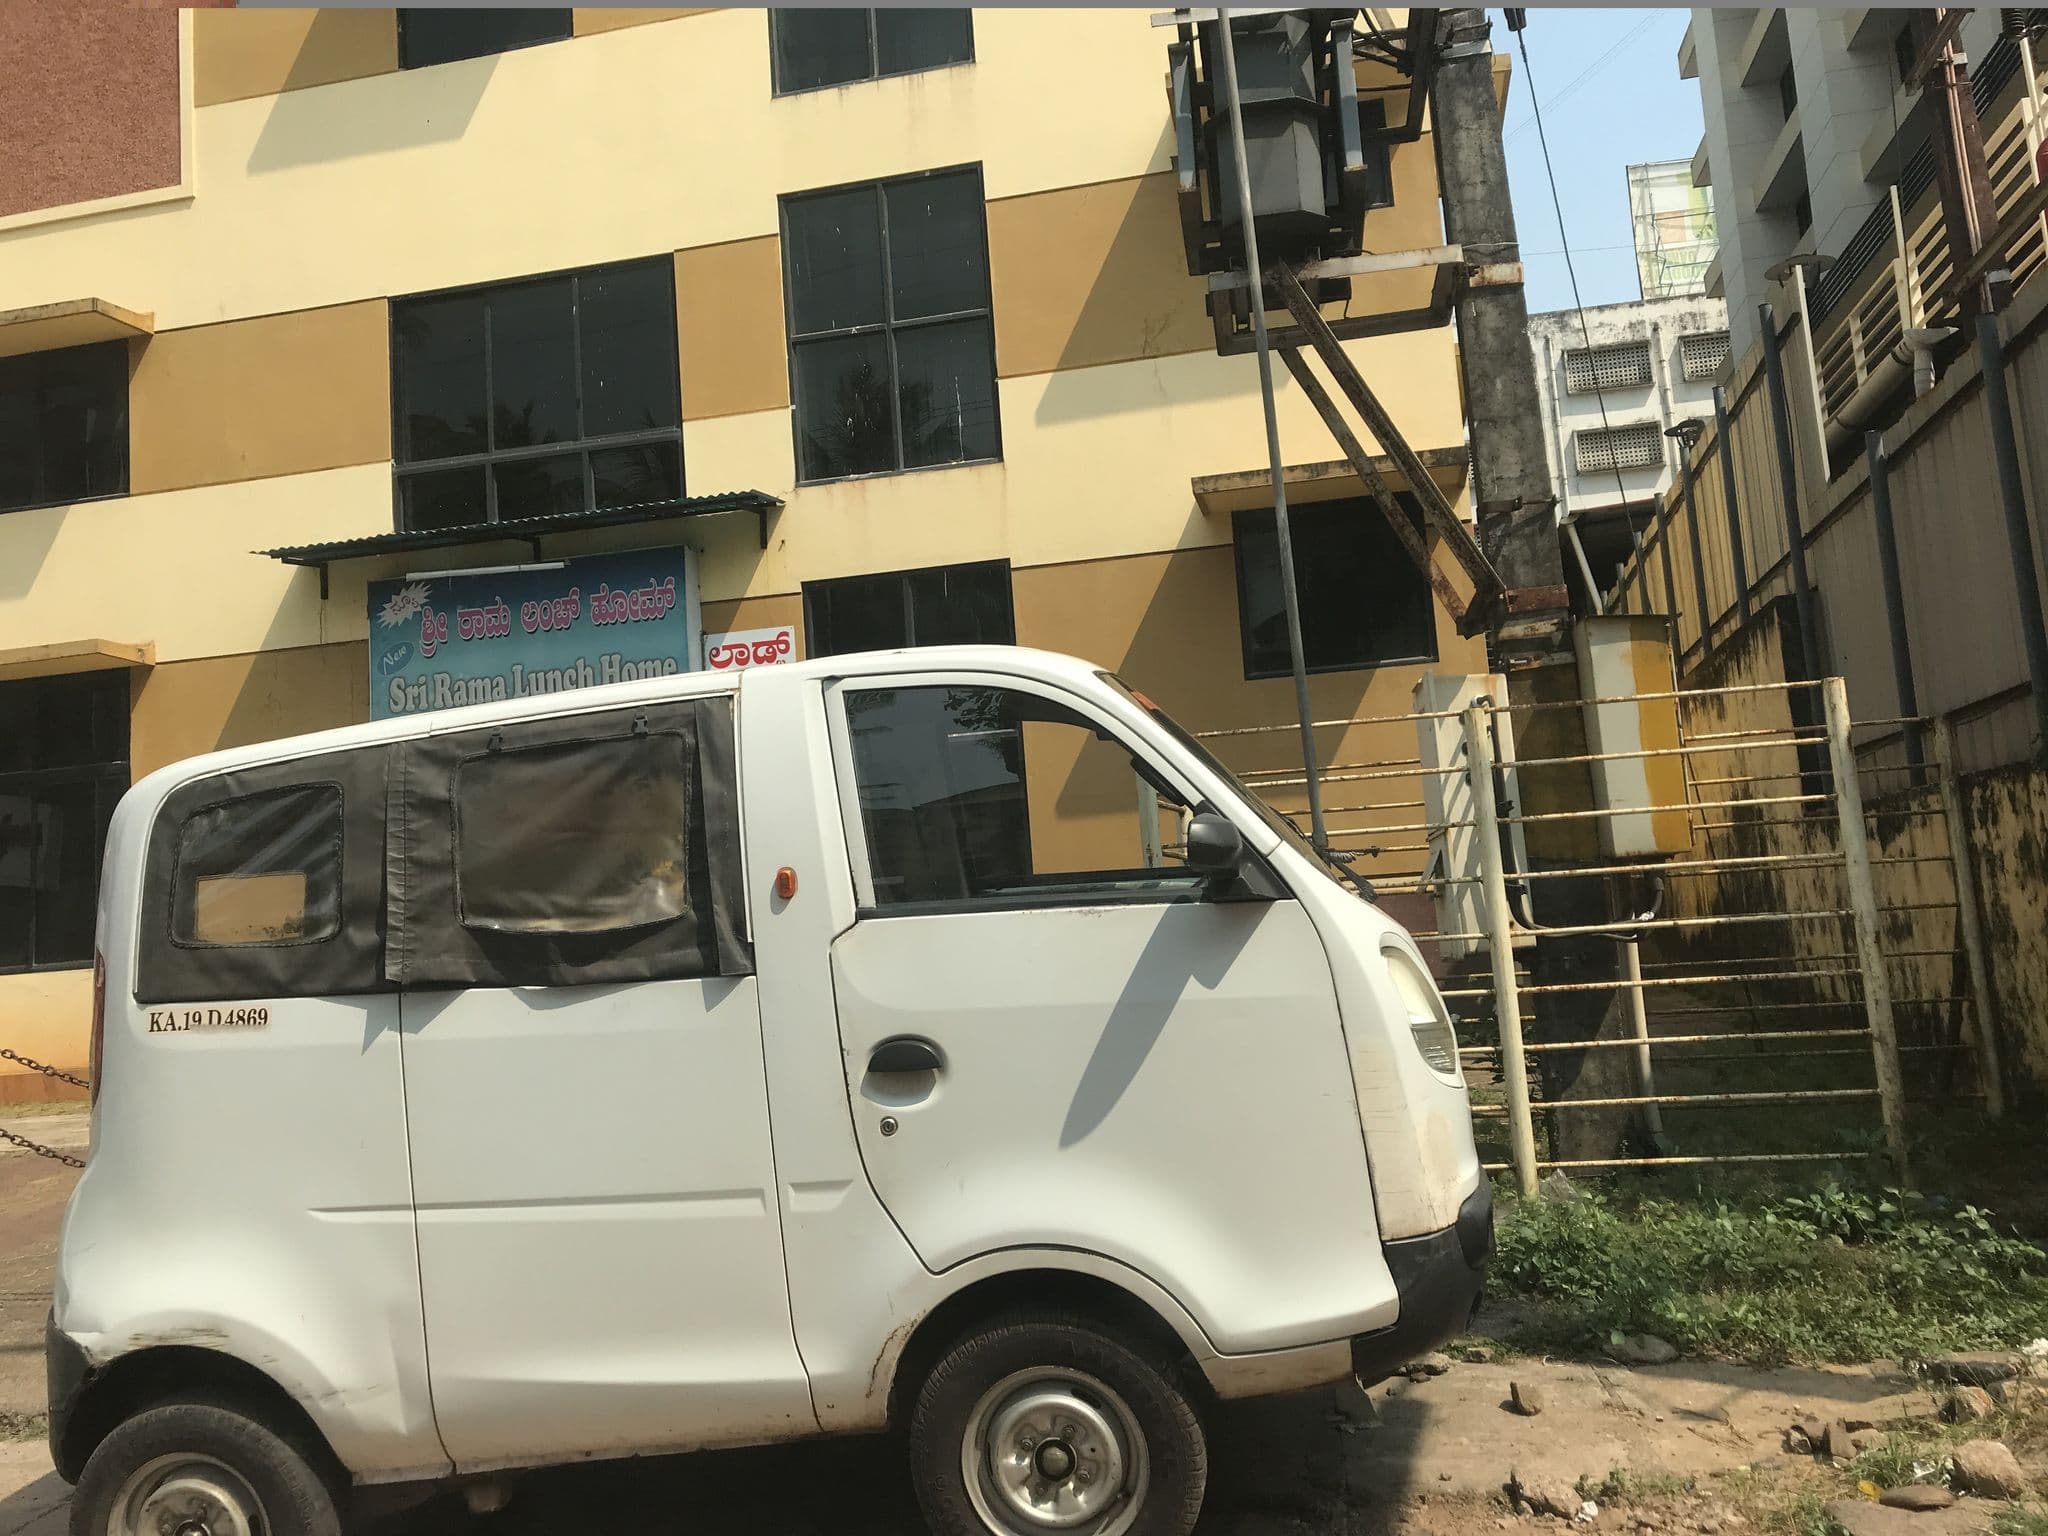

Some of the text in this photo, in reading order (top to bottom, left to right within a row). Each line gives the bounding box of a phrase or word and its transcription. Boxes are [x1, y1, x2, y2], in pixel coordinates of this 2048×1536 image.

[420, 576, 676, 657] ಶ್ರೀ ರಾಮ ಲಂಚ್ ಹೋಮ್
[382, 644, 408, 676] New
[389, 652, 678, 713] Sri Rama Lunch Home
